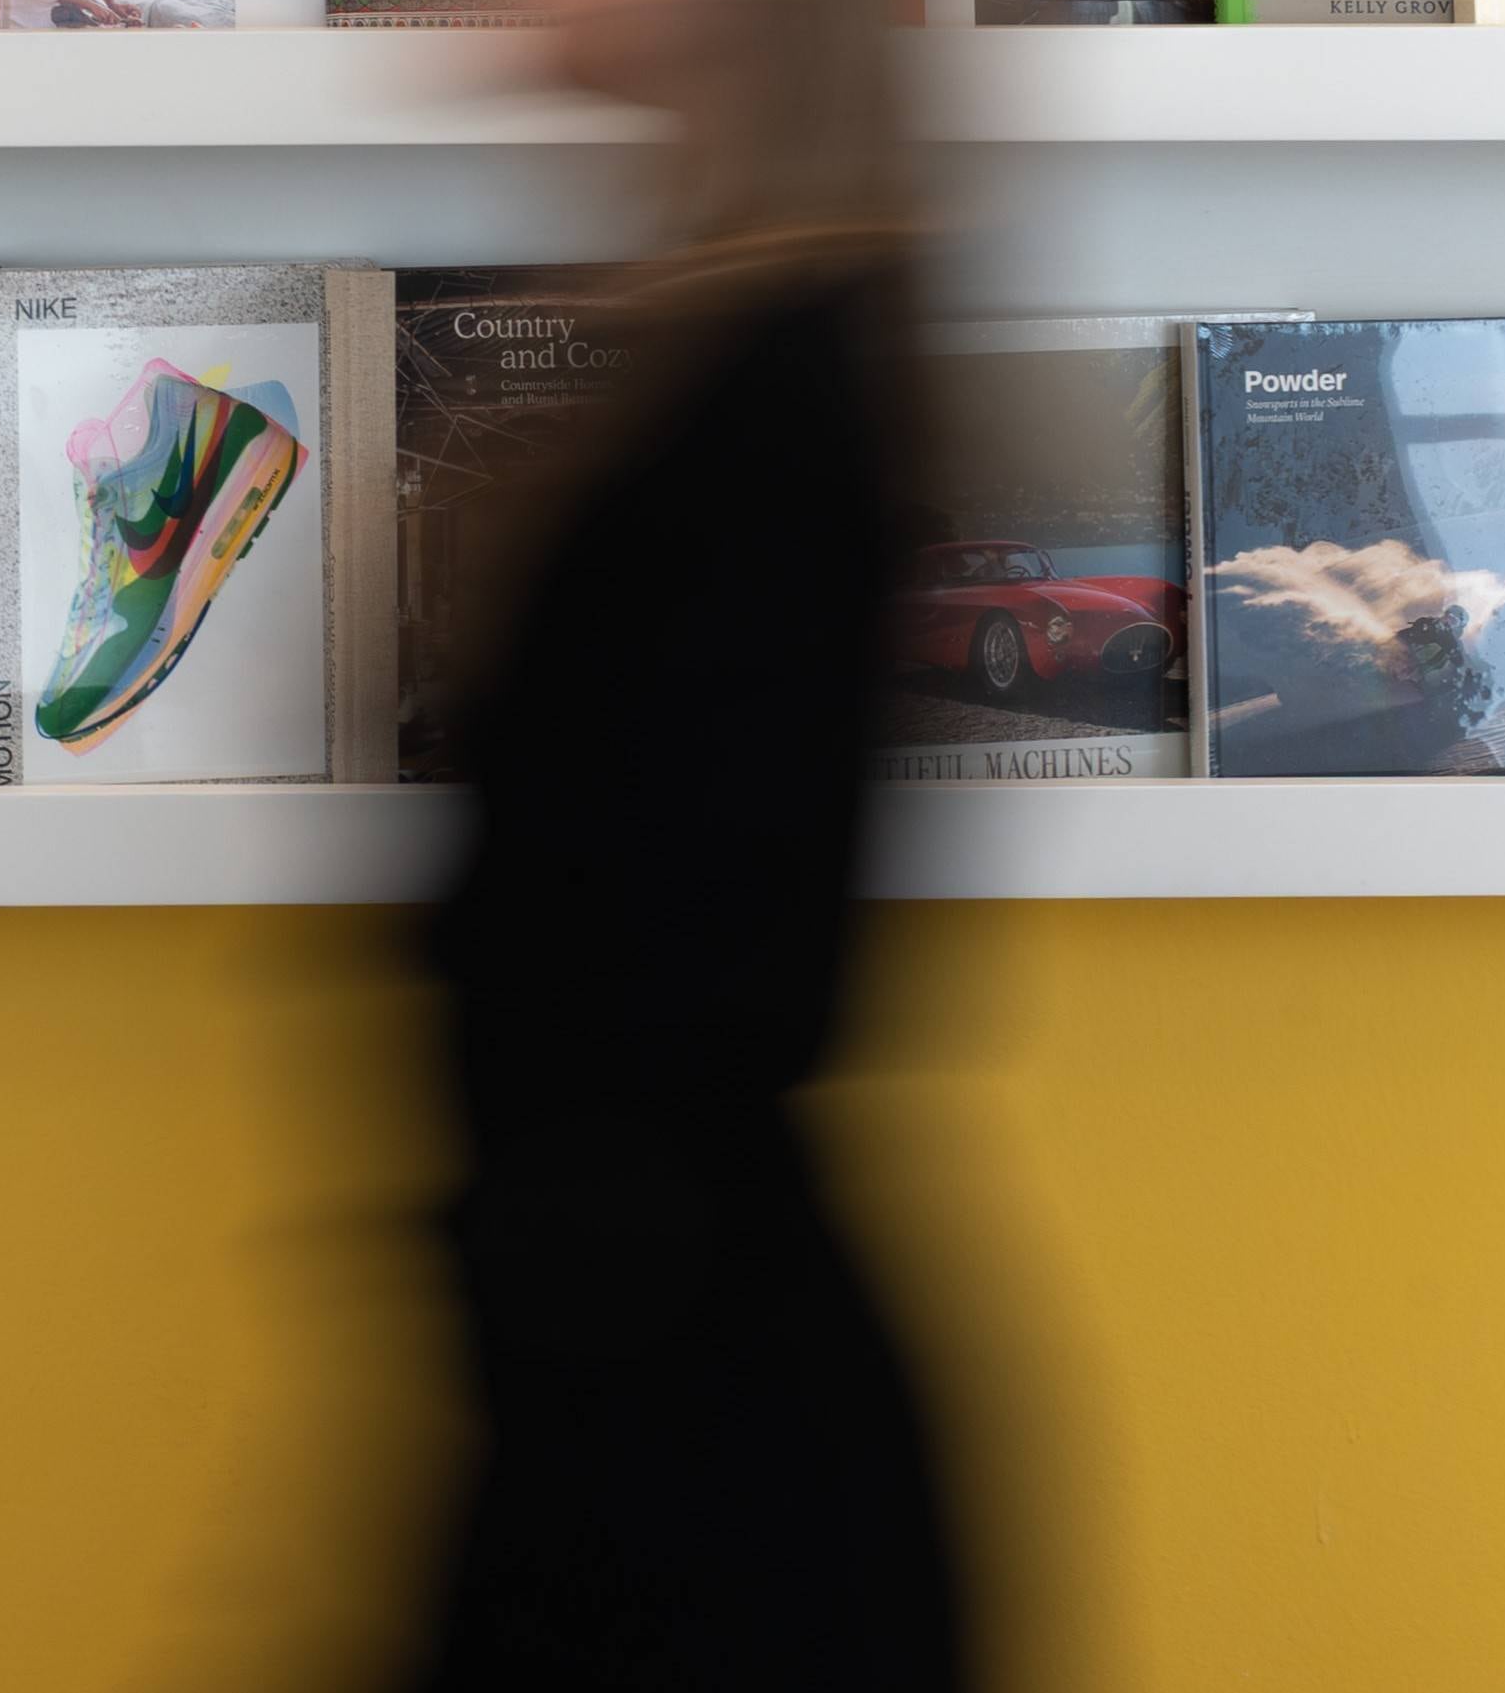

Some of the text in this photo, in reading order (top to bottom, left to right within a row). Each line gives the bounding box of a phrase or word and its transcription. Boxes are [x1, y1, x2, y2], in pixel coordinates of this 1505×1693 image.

[1329, 0, 1388, 15] KELLY
[14, 297, 77, 320] NIKE
[453, 311, 576, 344] Country
[500, 342, 556, 370] and
[1244, 368, 1347, 393] Powder
[500, 393, 524, 405] and
[1310, 397, 1326, 408] the
[983, 744, 1133, 780] MACHINES
